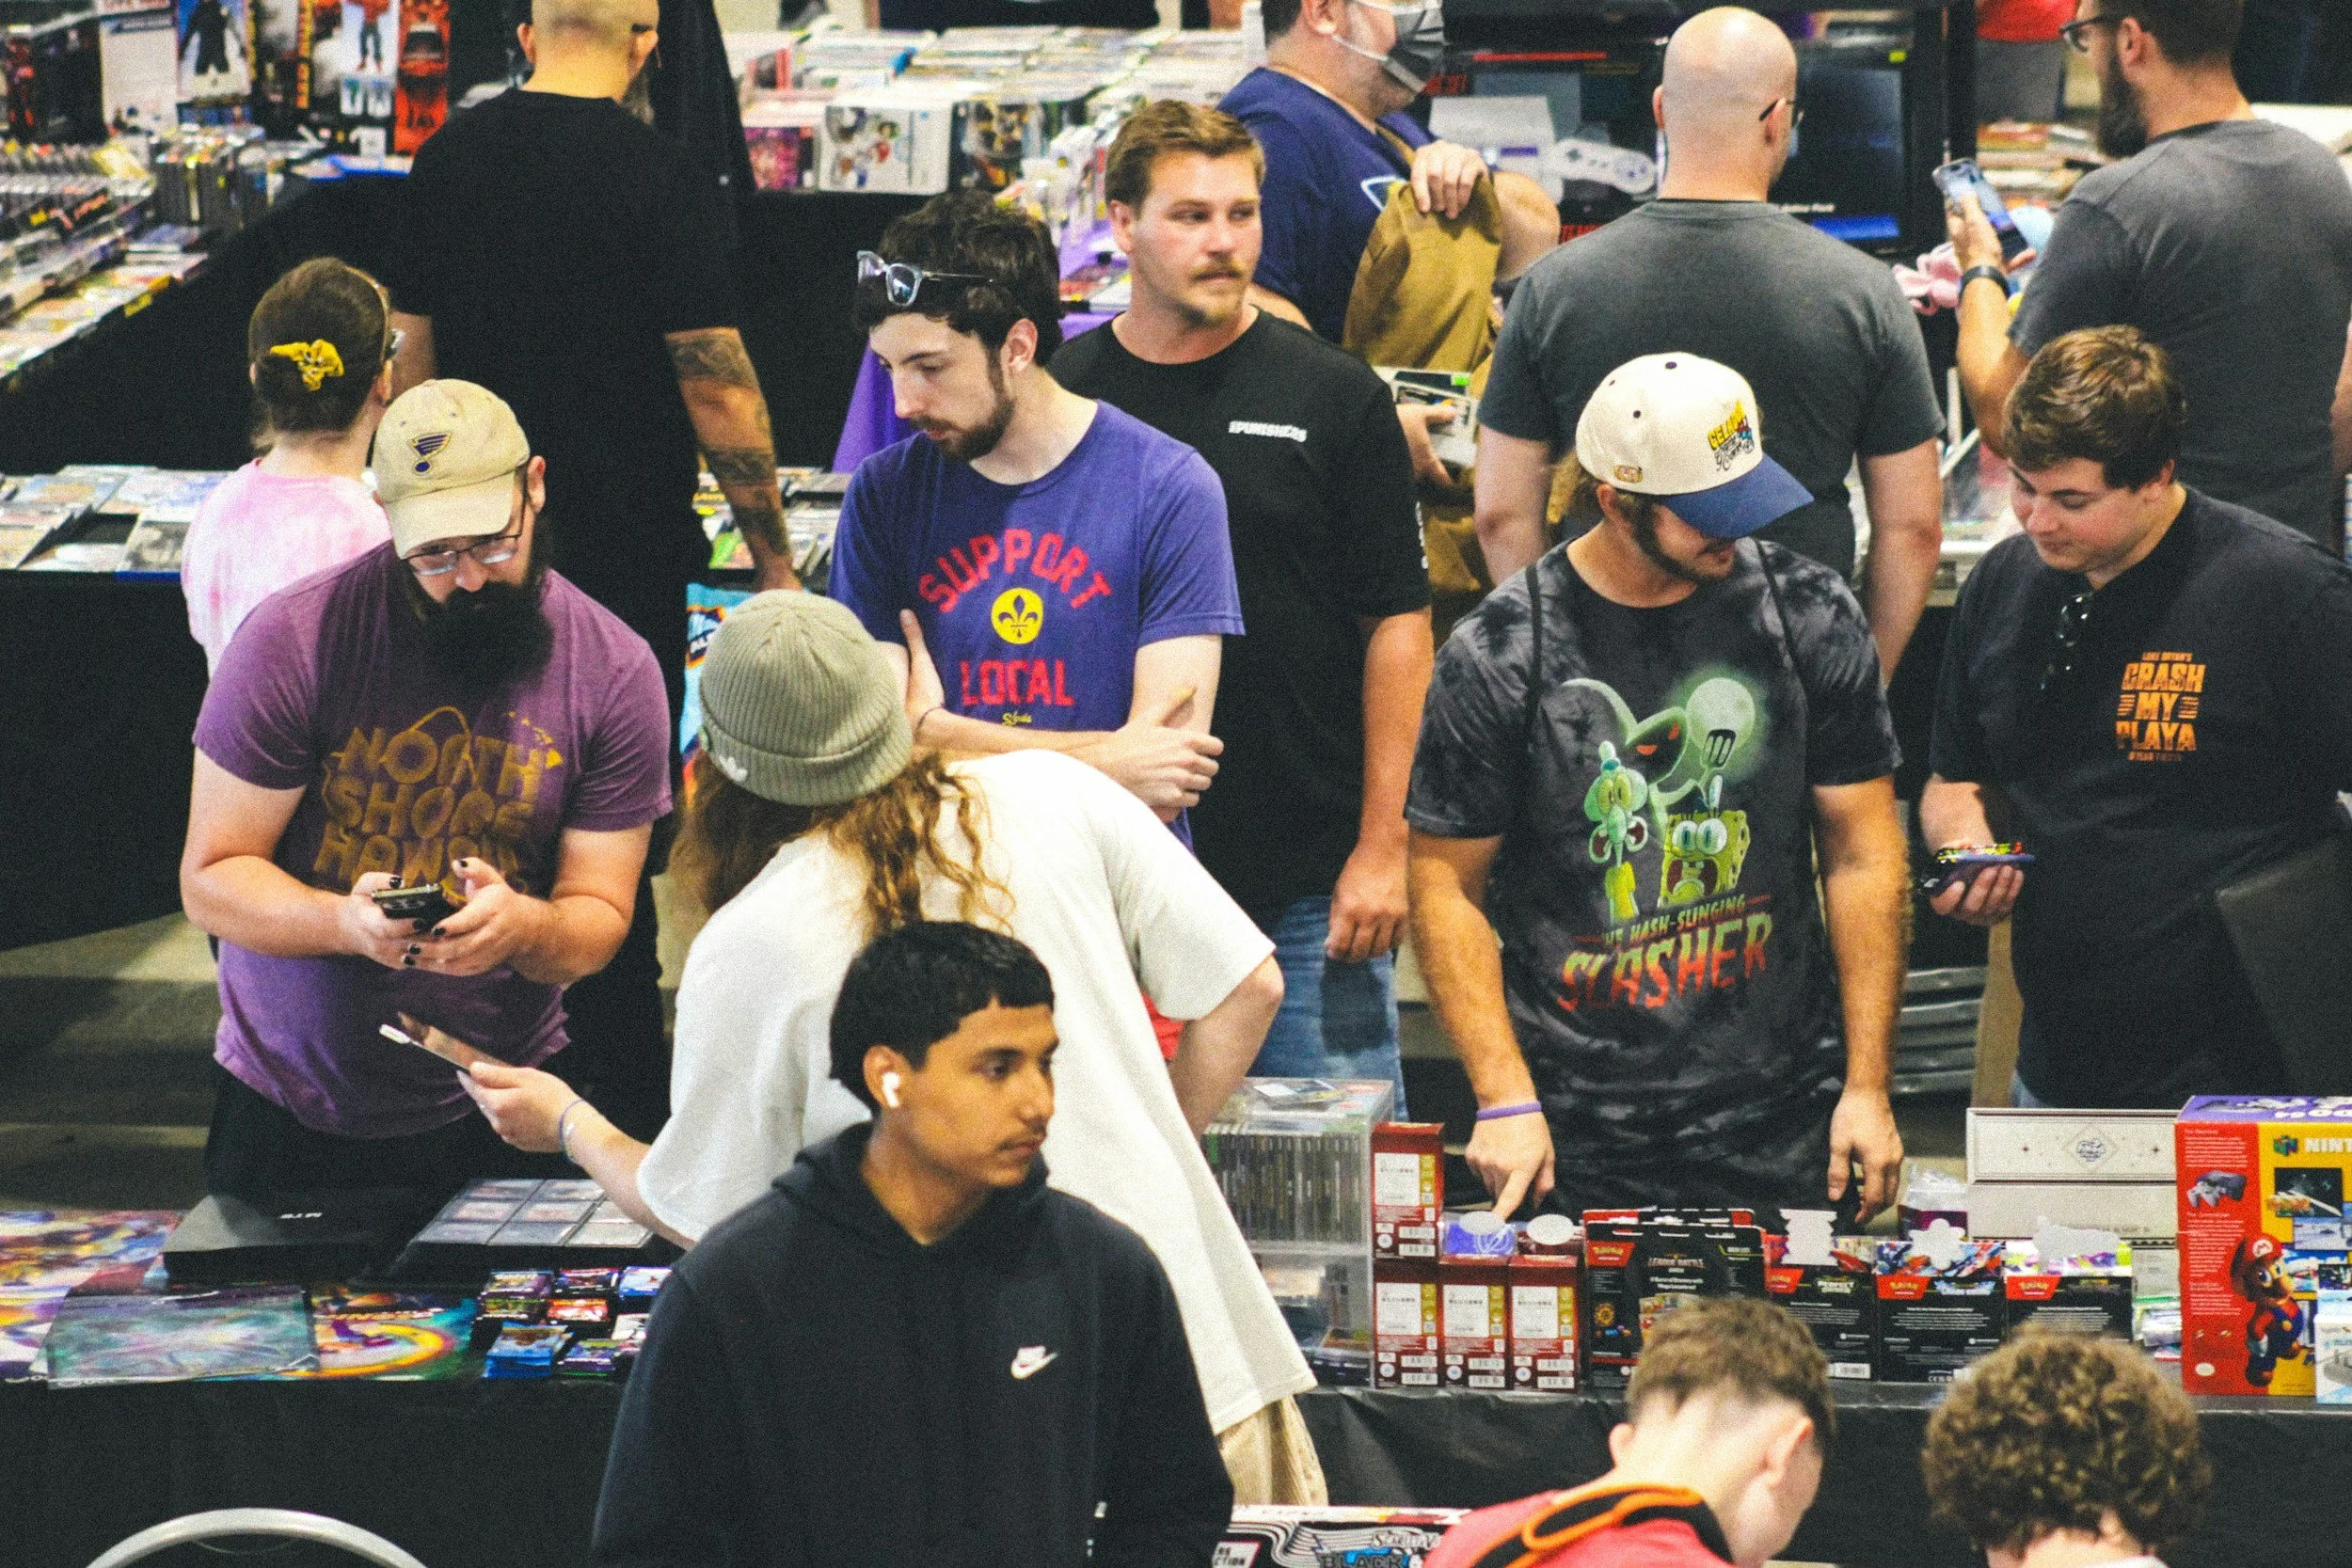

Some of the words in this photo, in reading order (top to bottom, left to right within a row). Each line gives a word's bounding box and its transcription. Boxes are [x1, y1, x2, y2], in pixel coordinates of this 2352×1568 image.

[918, 528, 1112, 613] SUPPORT
[960, 658, 1075, 706] LOCAL
[2121, 662, 2206, 693] CRASH
[2135, 691, 2180, 721] MY
[2115, 721, 2197, 751] PLAYA
[337, 726, 543, 802] NORTH
[327, 775, 534, 839] SHORE
[1630, 894, 1746, 942] HASH-SLINGING
[1557, 911, 1772, 1012] SLASHER
